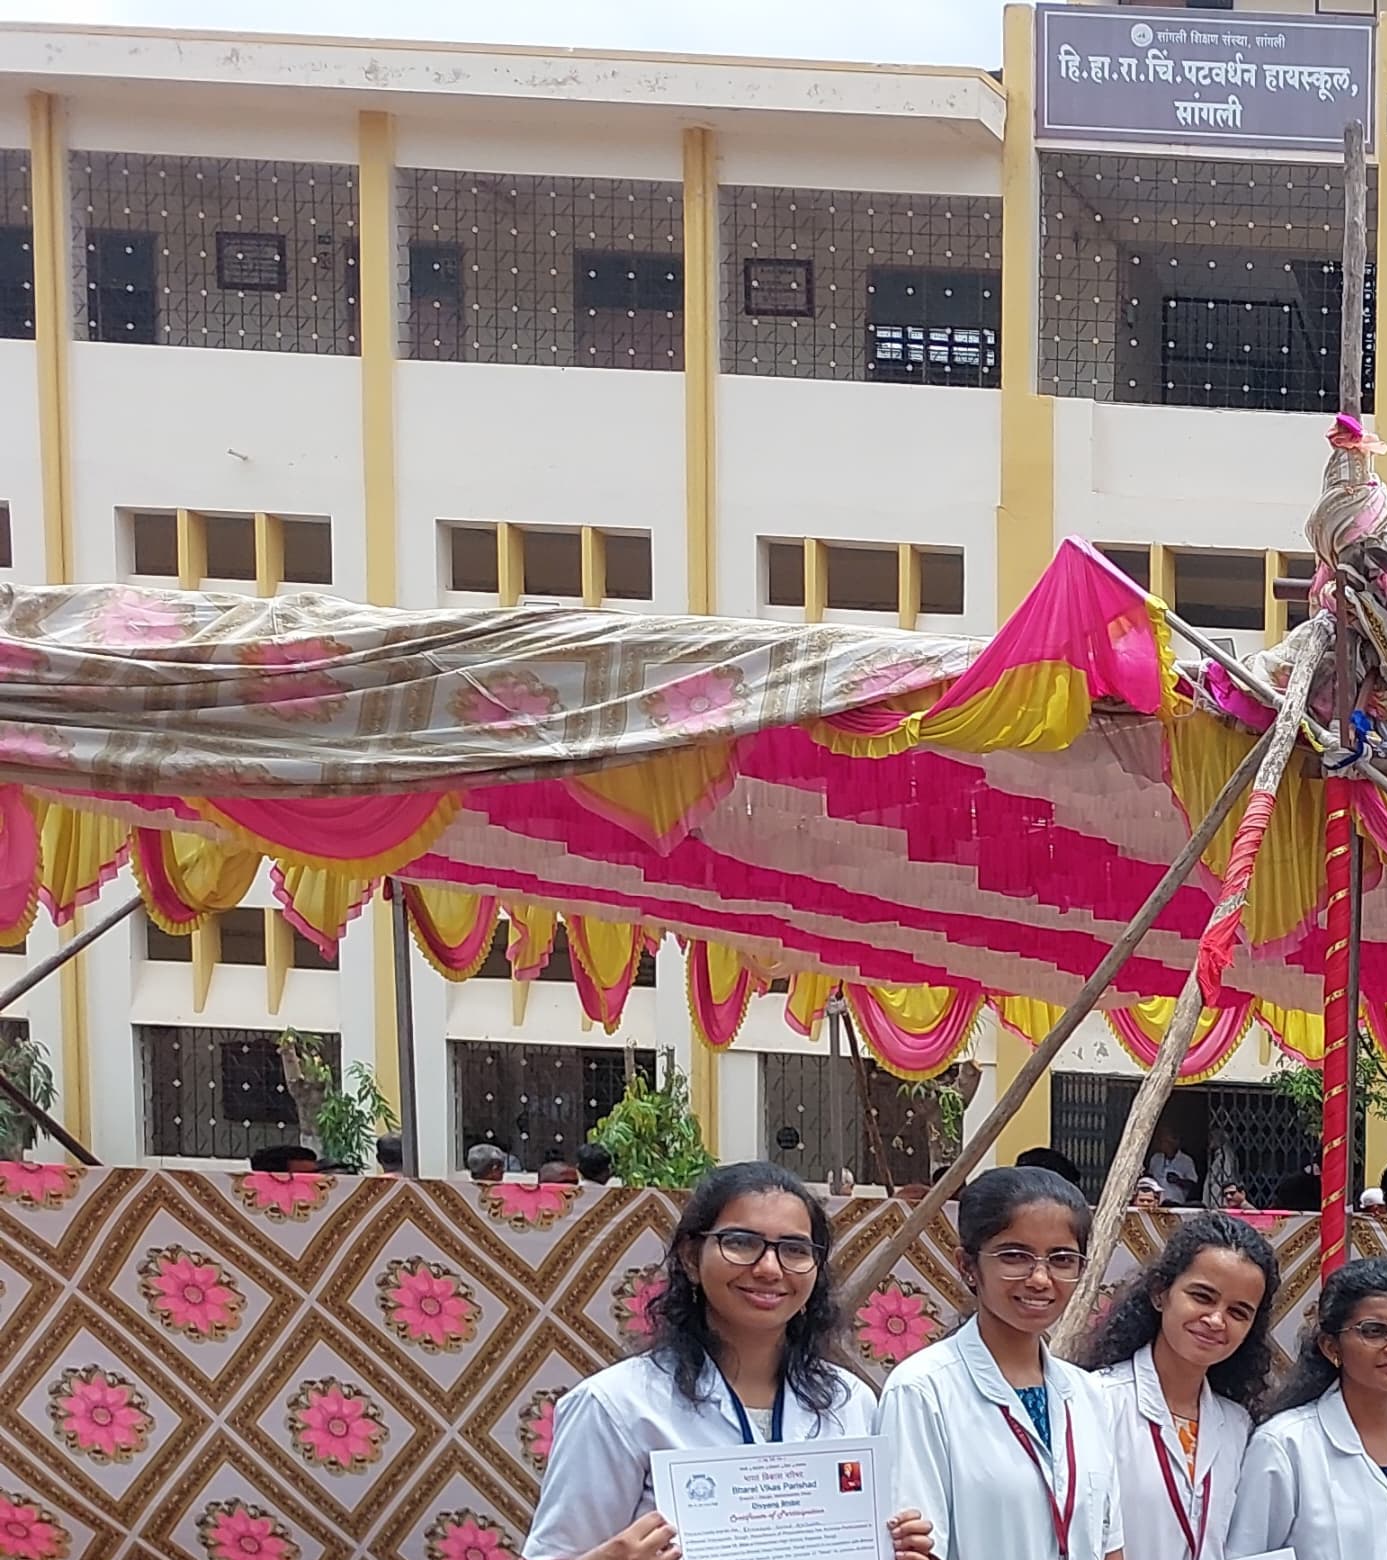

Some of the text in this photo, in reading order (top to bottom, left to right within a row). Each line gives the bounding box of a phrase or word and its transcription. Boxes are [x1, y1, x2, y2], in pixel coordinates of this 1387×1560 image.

[1157, 30, 1188, 43] सांगली
[1256, 31, 1286, 48] सांगली
[1263, 64, 1358, 101] हायस्कूल,
[1174, 92, 1243, 129] सांगली
